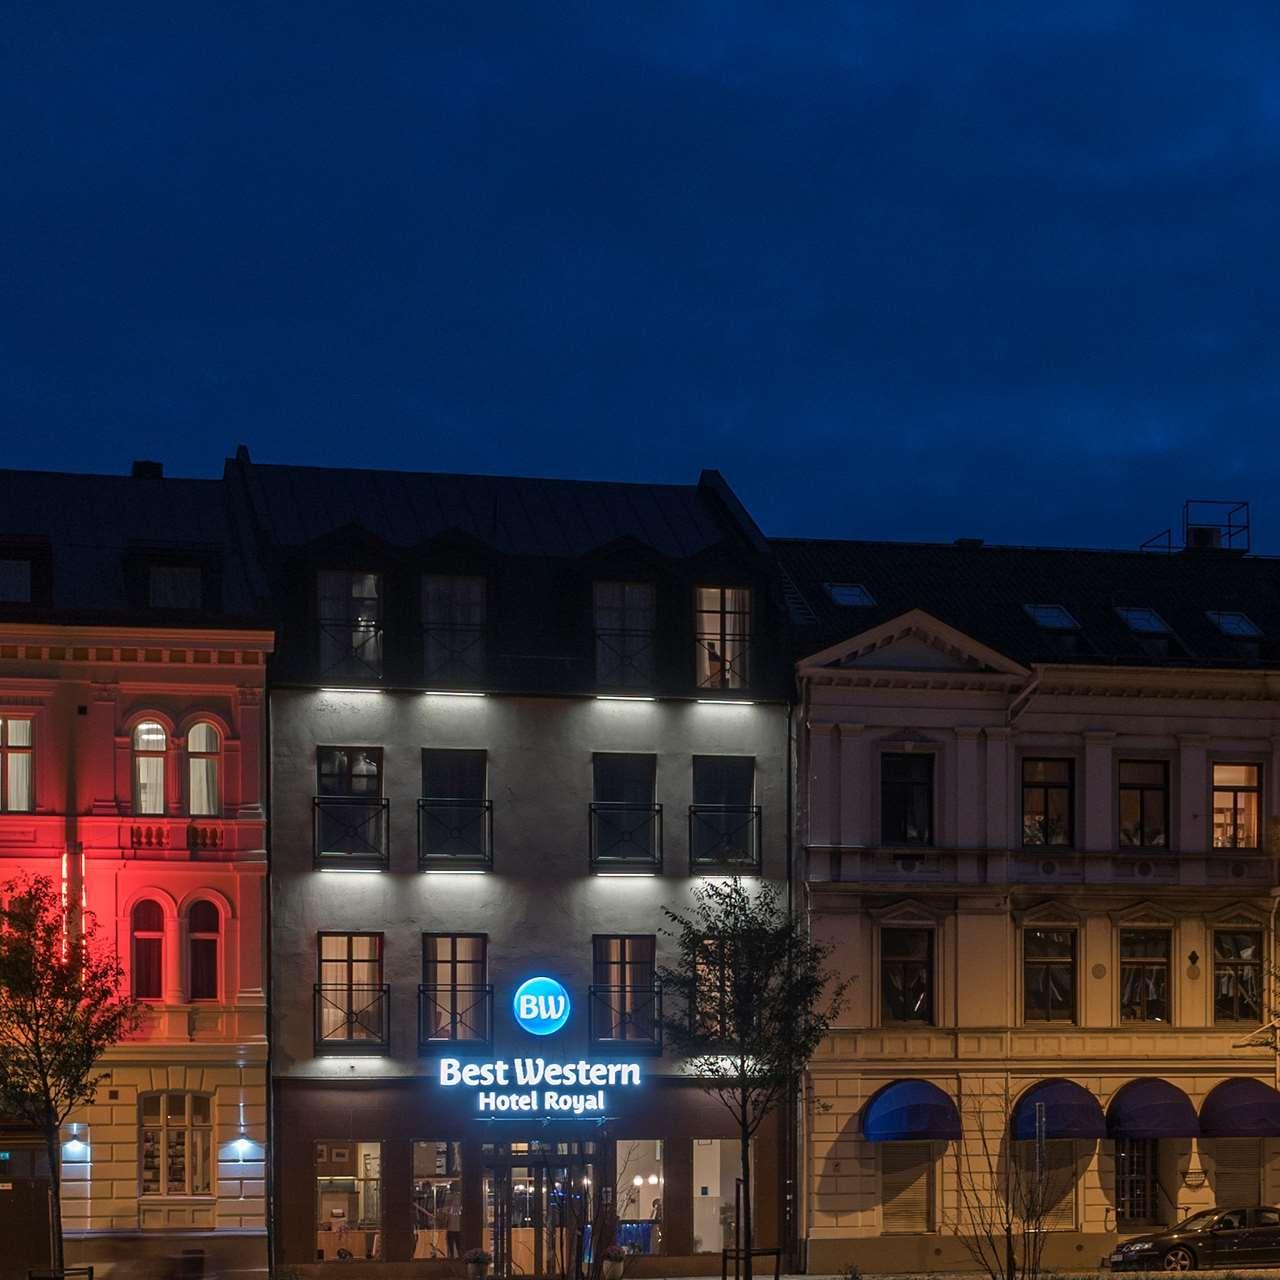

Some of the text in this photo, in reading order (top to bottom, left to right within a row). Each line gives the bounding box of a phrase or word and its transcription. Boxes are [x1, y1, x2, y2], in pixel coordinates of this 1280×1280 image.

[520, 995, 565, 1019] BW
[439, 1058, 641, 1086] Best Western
[478, 1090, 605, 1114] Hotel Royal
